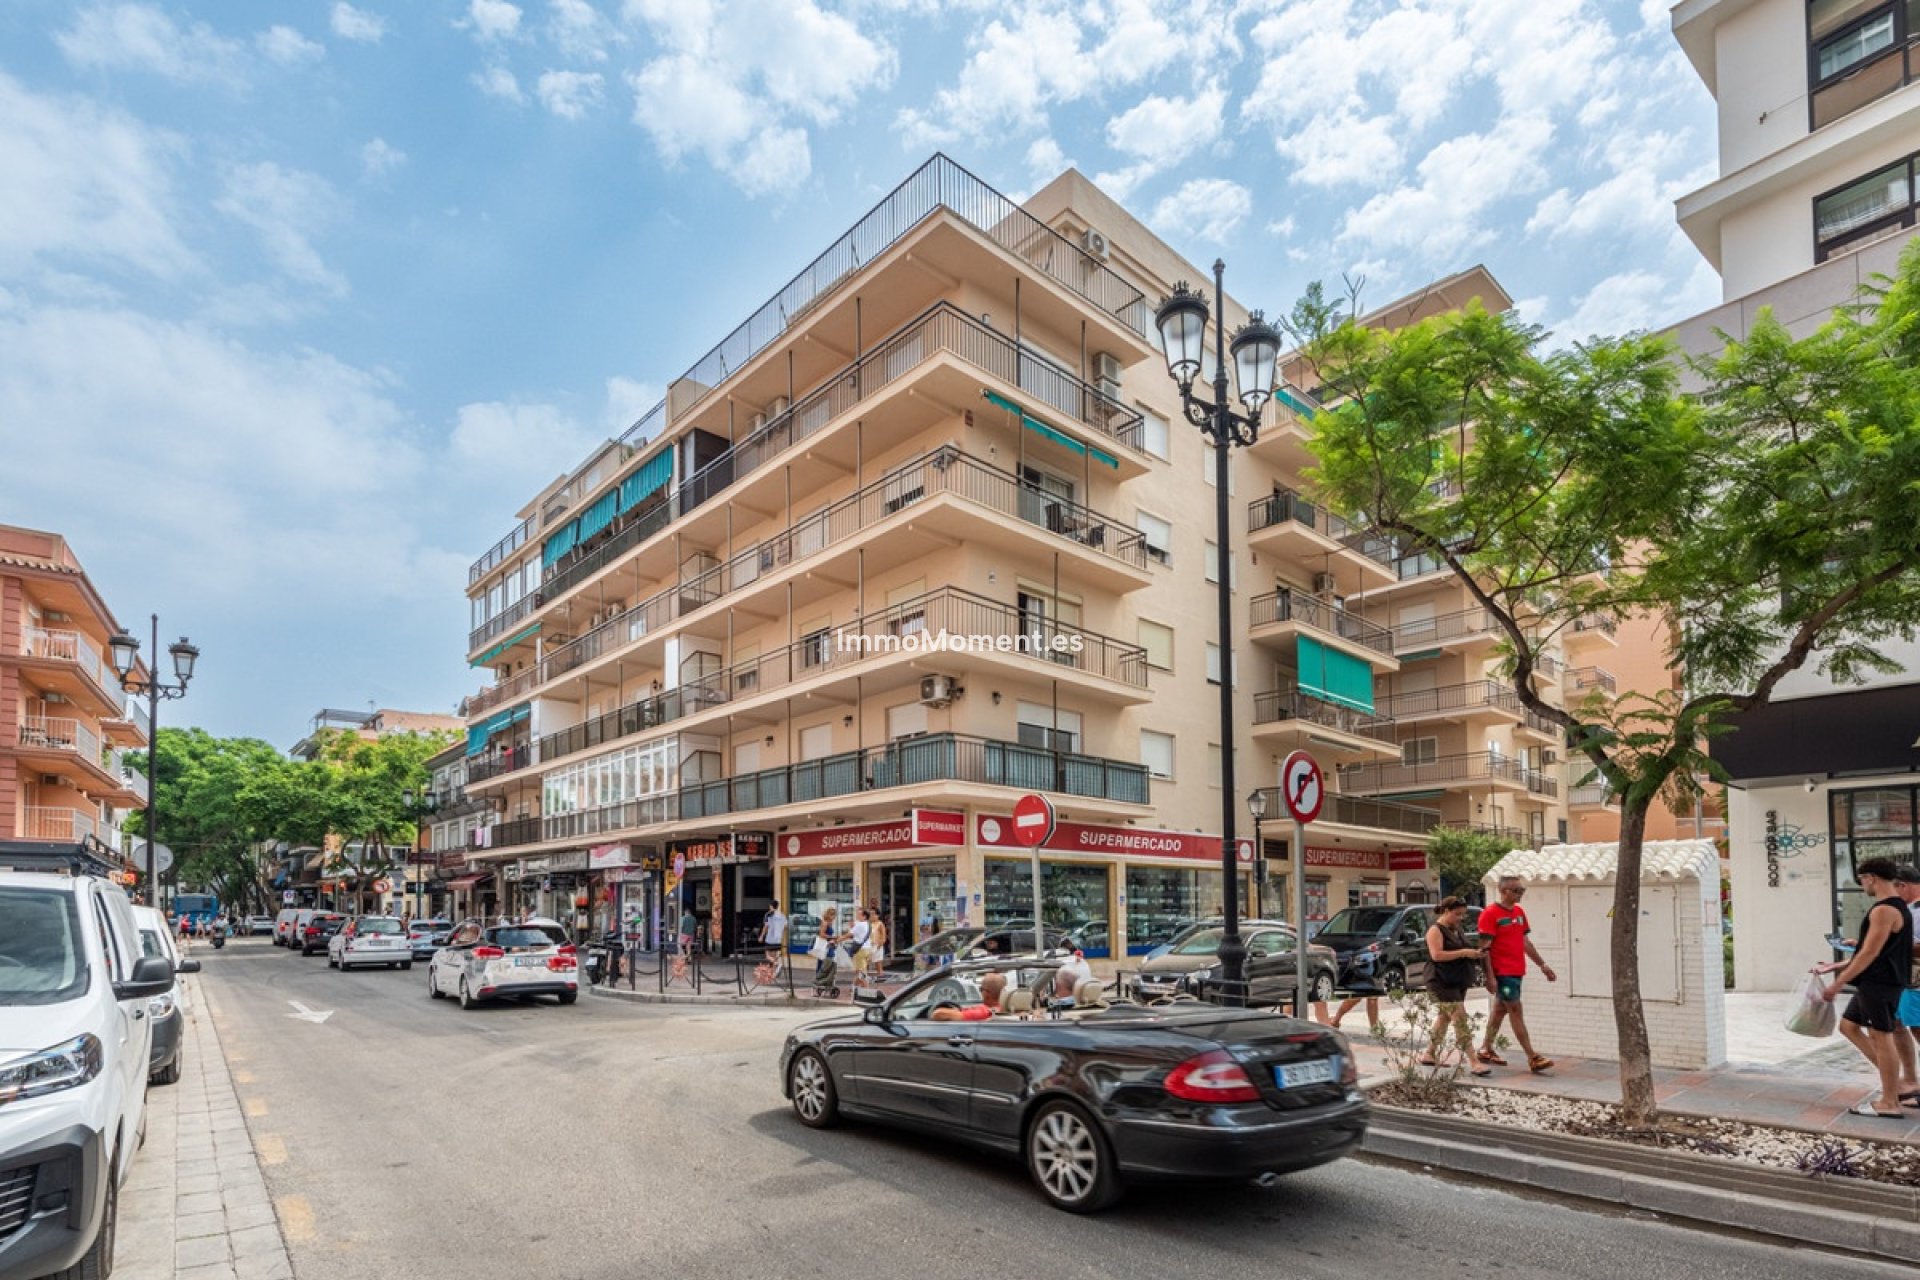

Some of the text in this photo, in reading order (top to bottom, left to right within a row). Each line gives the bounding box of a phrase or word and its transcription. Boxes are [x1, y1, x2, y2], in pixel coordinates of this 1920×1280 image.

[919, 821, 965, 833] SUPERMARKET
[821, 827, 912, 849] SUPERMERCADO
[1079, 831, 1182, 851] SUPERMERCADO
[1306, 850, 1380, 866] SUPERMERCADO
[1766, 810, 1779, 887] ROOFTOP BAR
